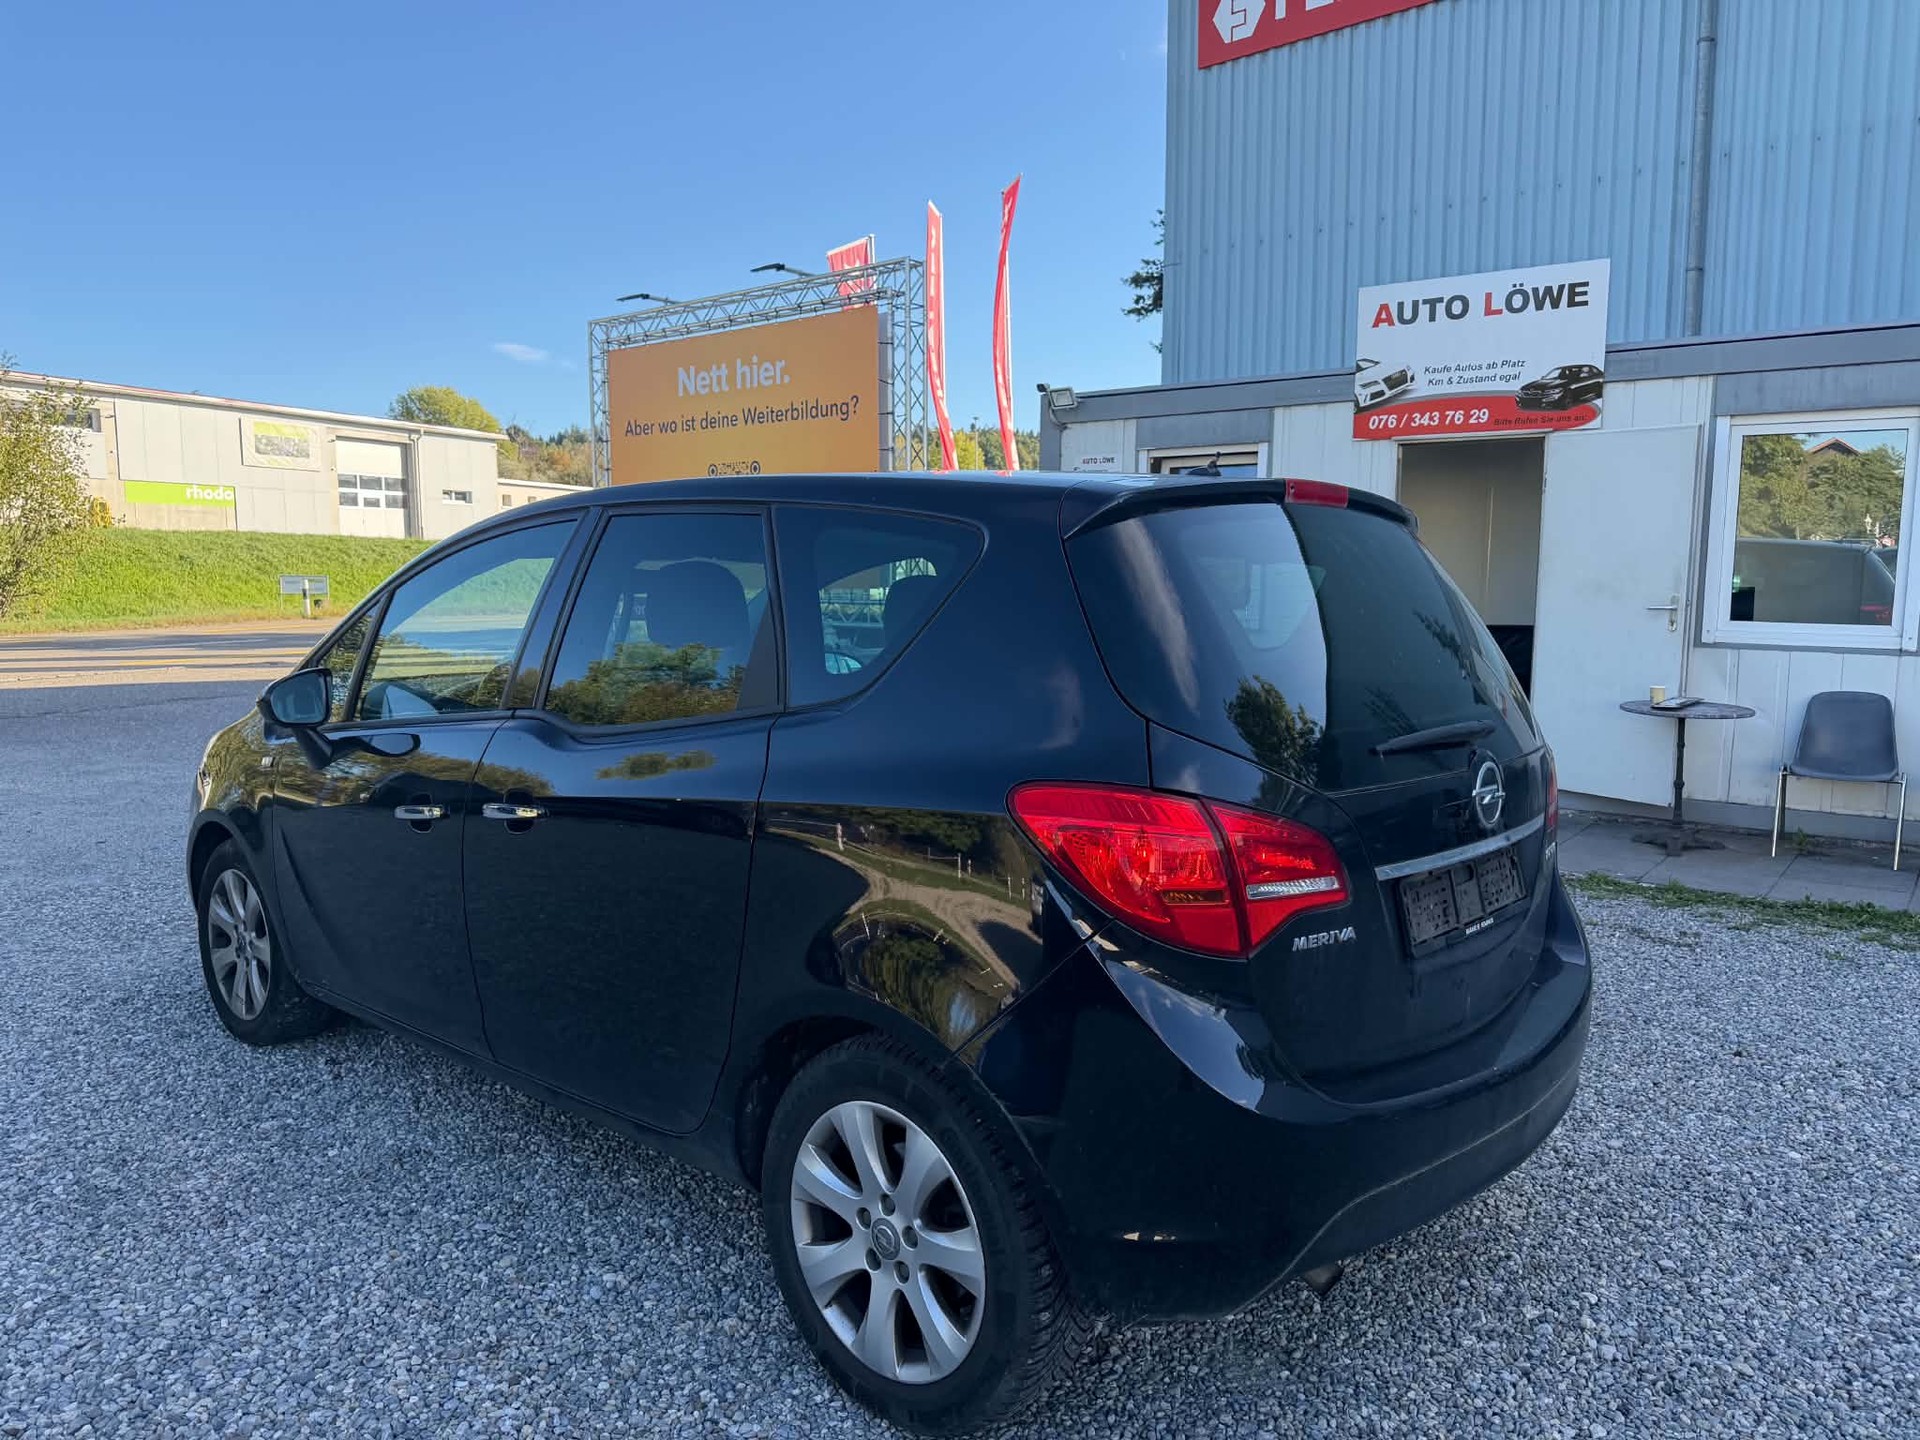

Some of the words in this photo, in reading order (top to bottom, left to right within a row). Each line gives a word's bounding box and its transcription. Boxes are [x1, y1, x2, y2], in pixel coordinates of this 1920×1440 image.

[1372, 294, 1470, 328] AUTO
[1484, 281, 1590, 316] LÖWE
[677, 363, 729, 397] Nett
[736, 354, 791, 390] hier.
[1424, 366, 1452, 375] Kaufe
[1454, 363, 1483, 372] Autos
[1486, 361, 1498, 370] ab
[1501, 359, 1526, 369] Platz
[1428, 378, 1444, 387] Km
[1447, 375, 1453, 385] &
[1456, 373, 1497, 384] Zustand
[1500, 371, 1521, 383] egal
[625, 420, 655, 437] Aber
[658, 421, 677, 434] wo
[681, 415, 696, 432] ist
[700, 412, 739, 430] deine
[742, 395, 860, 426] Weiterbildung?
[1369, 415, 1398, 430] 076
[1399, 413, 1408, 428] /
[1411, 412, 1440, 427] 343
[1445, 410, 1464, 425] 76
[1469, 408, 1489, 424] 29
[1082, 457, 1098, 465] AUTO
[186, 484, 234, 500] rhodo
[1292, 926, 1356, 952] MERIVA
